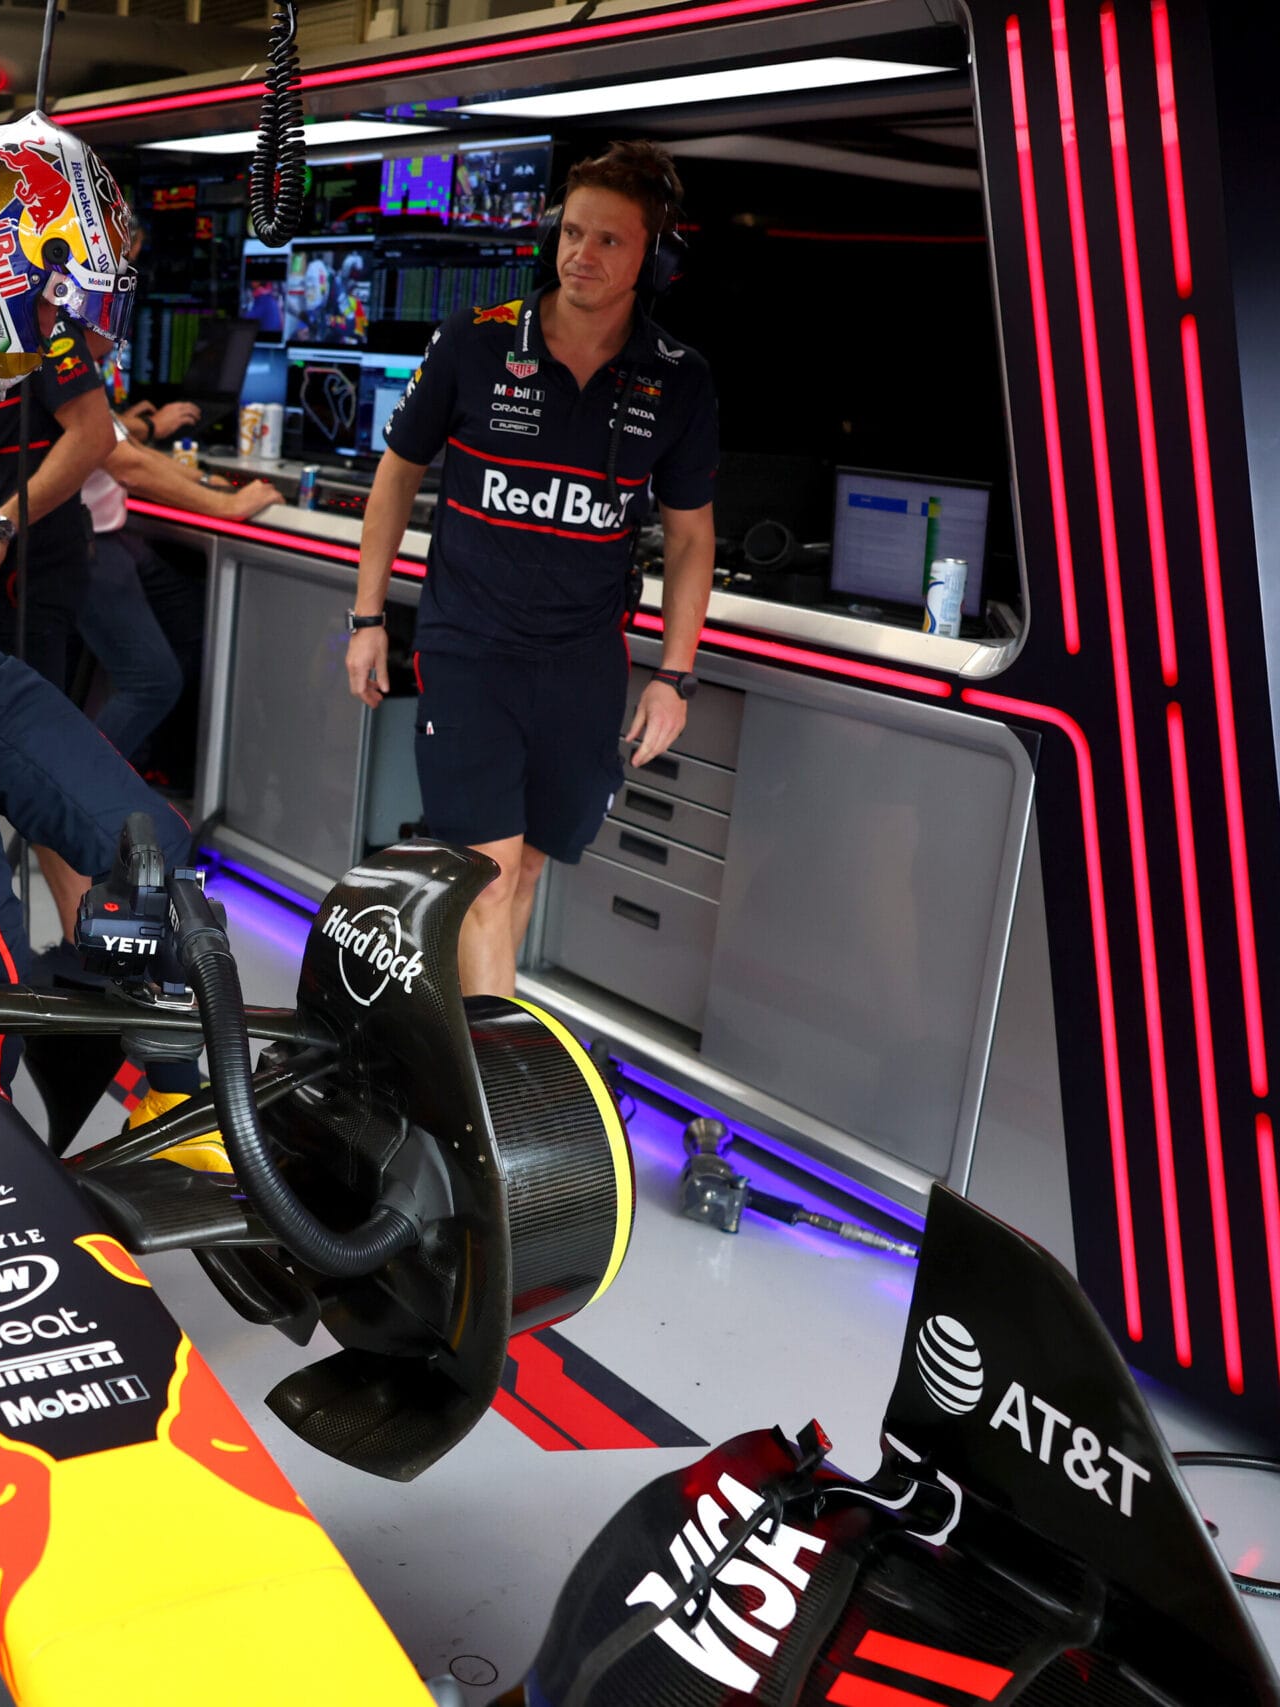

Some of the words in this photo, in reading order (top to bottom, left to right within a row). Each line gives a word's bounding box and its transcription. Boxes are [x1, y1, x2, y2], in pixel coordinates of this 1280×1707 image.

[71, 160, 95, 227] Heineken
[491, 402, 542, 418] ORACLE
[493, 383, 530, 400] Mobil
[481, 469, 560, 519] Red
[102, 935, 158, 955] YETI
[322, 904, 378, 957] Hard
[0, 1382, 111, 1427] Mobil
[990, 1381, 1151, 1517] AT&T
[625, 1472, 826, 1694] VISA
